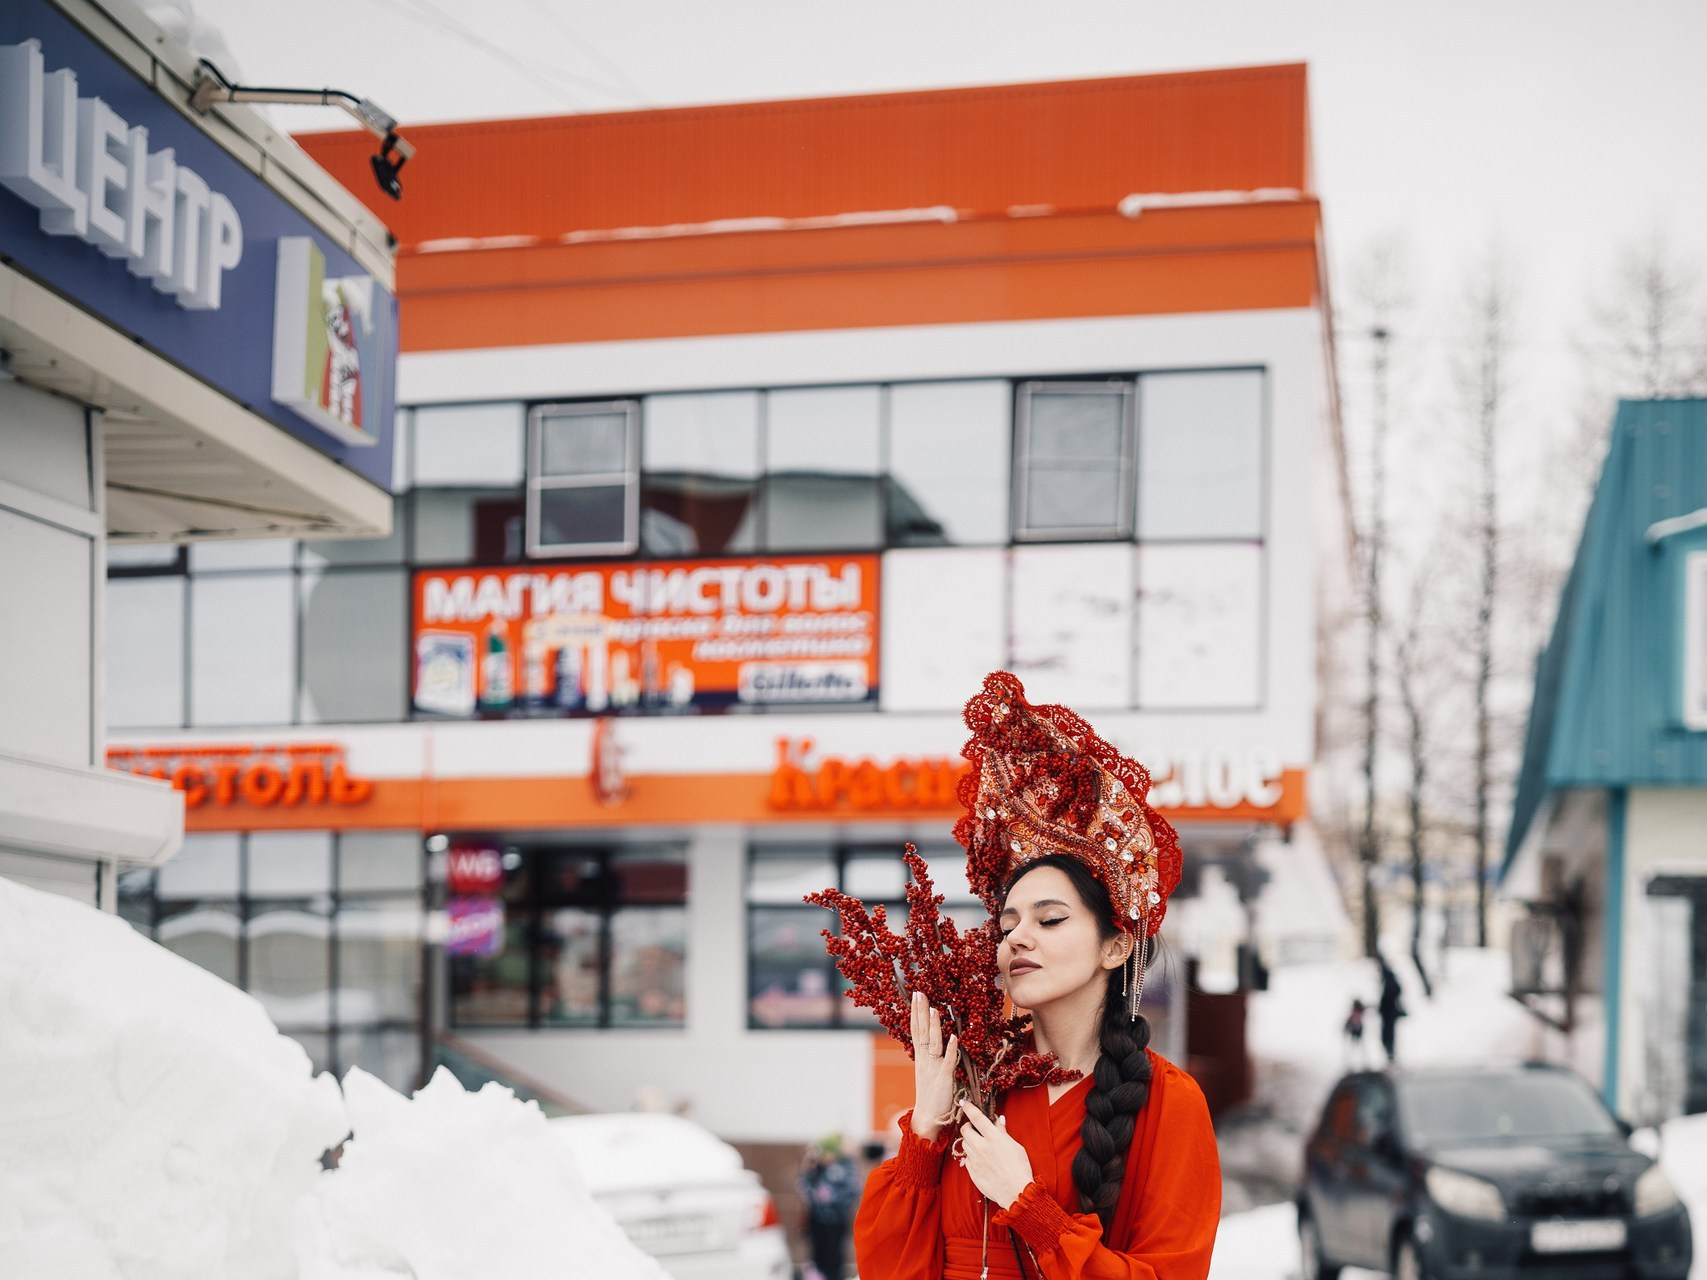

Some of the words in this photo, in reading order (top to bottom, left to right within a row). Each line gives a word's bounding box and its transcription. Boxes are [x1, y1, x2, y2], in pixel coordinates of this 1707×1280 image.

[4, 38, 243, 311] ЦЕНТР
[424, 571, 602, 621] МАГИЯ
[610, 563, 863, 615] ЧИСТОТЫ
